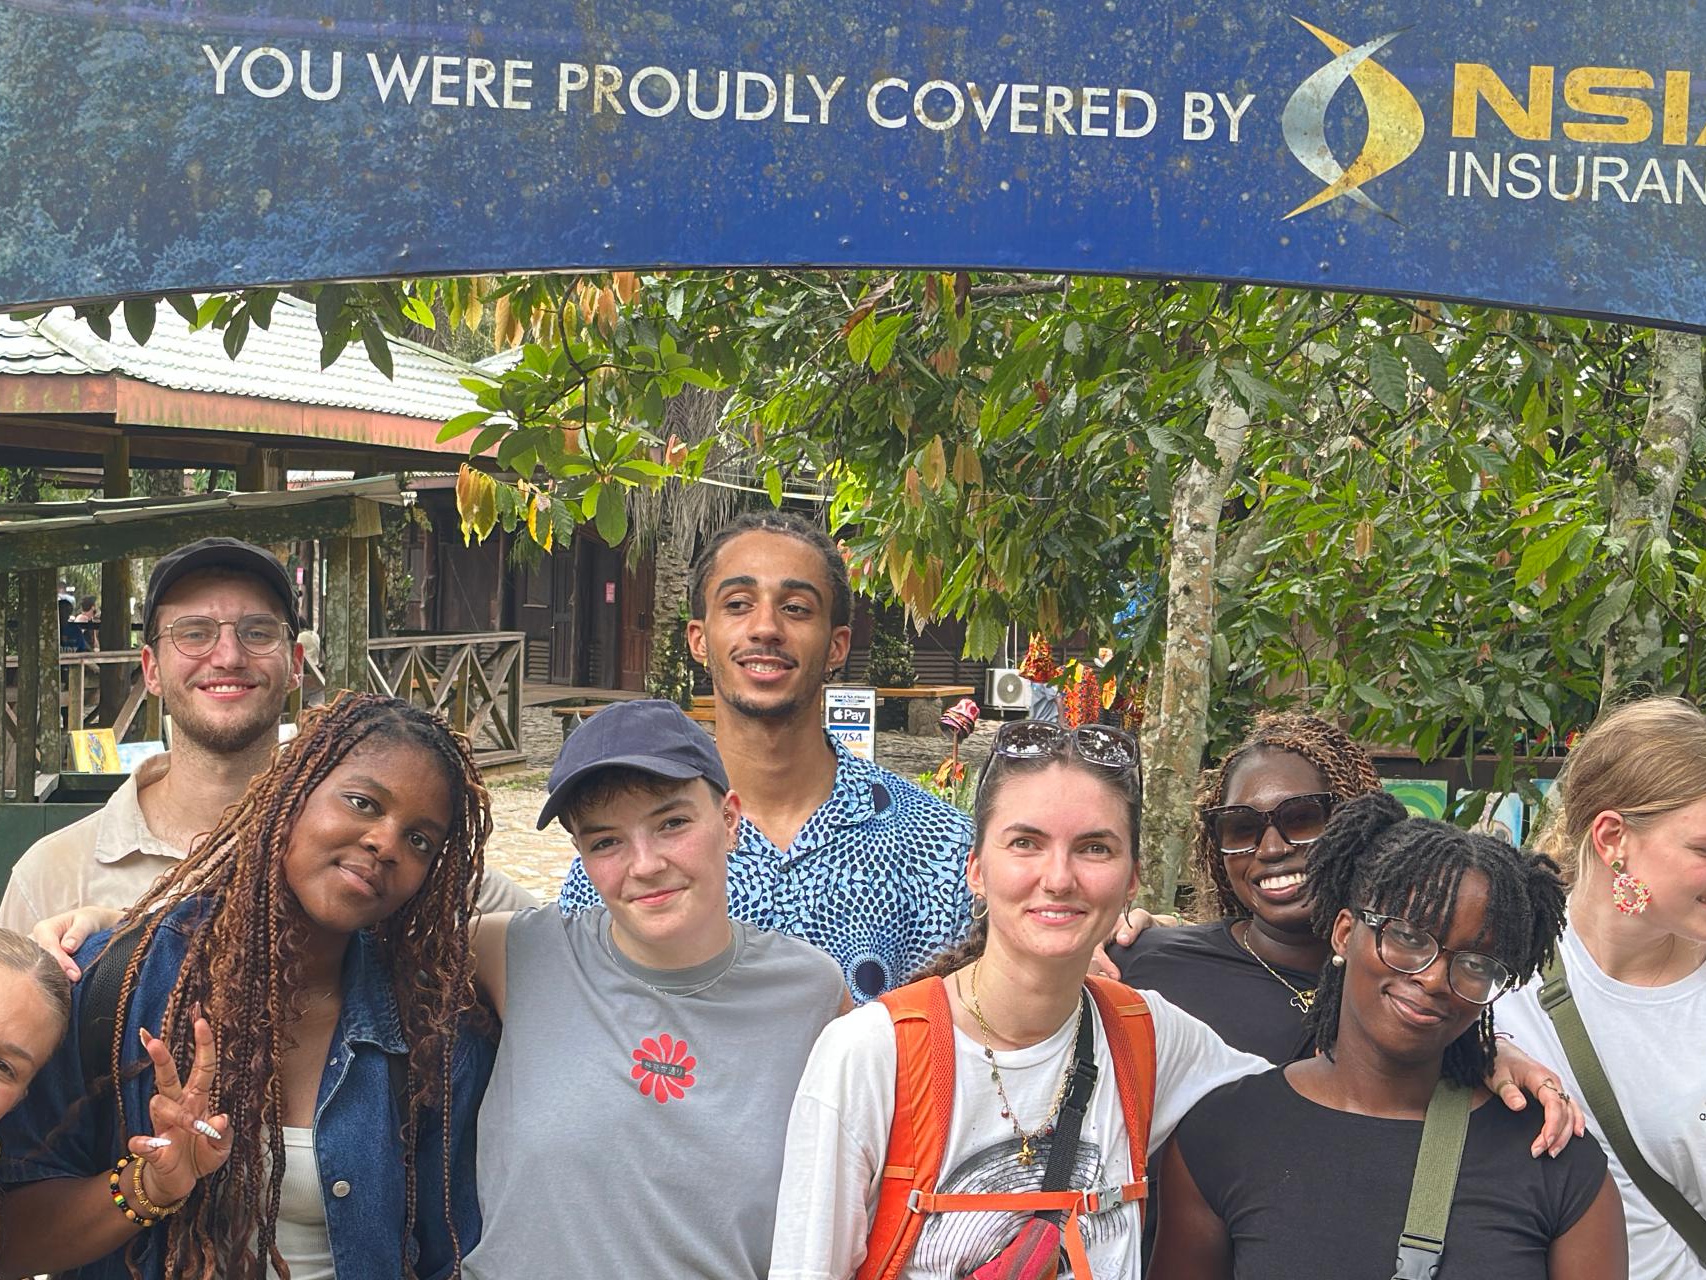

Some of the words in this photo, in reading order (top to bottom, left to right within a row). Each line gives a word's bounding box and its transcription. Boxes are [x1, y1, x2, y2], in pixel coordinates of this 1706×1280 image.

[201, 45, 343, 101] YOU
[366, 53, 533, 110] WERE
[558, 63, 846, 125] PROUDLY
[866, 77, 1158, 138] COVERED
[1182, 91, 1256, 144] BY
[844, 709, 866, 723] Pay
[836, 732, 863, 742] VISA
